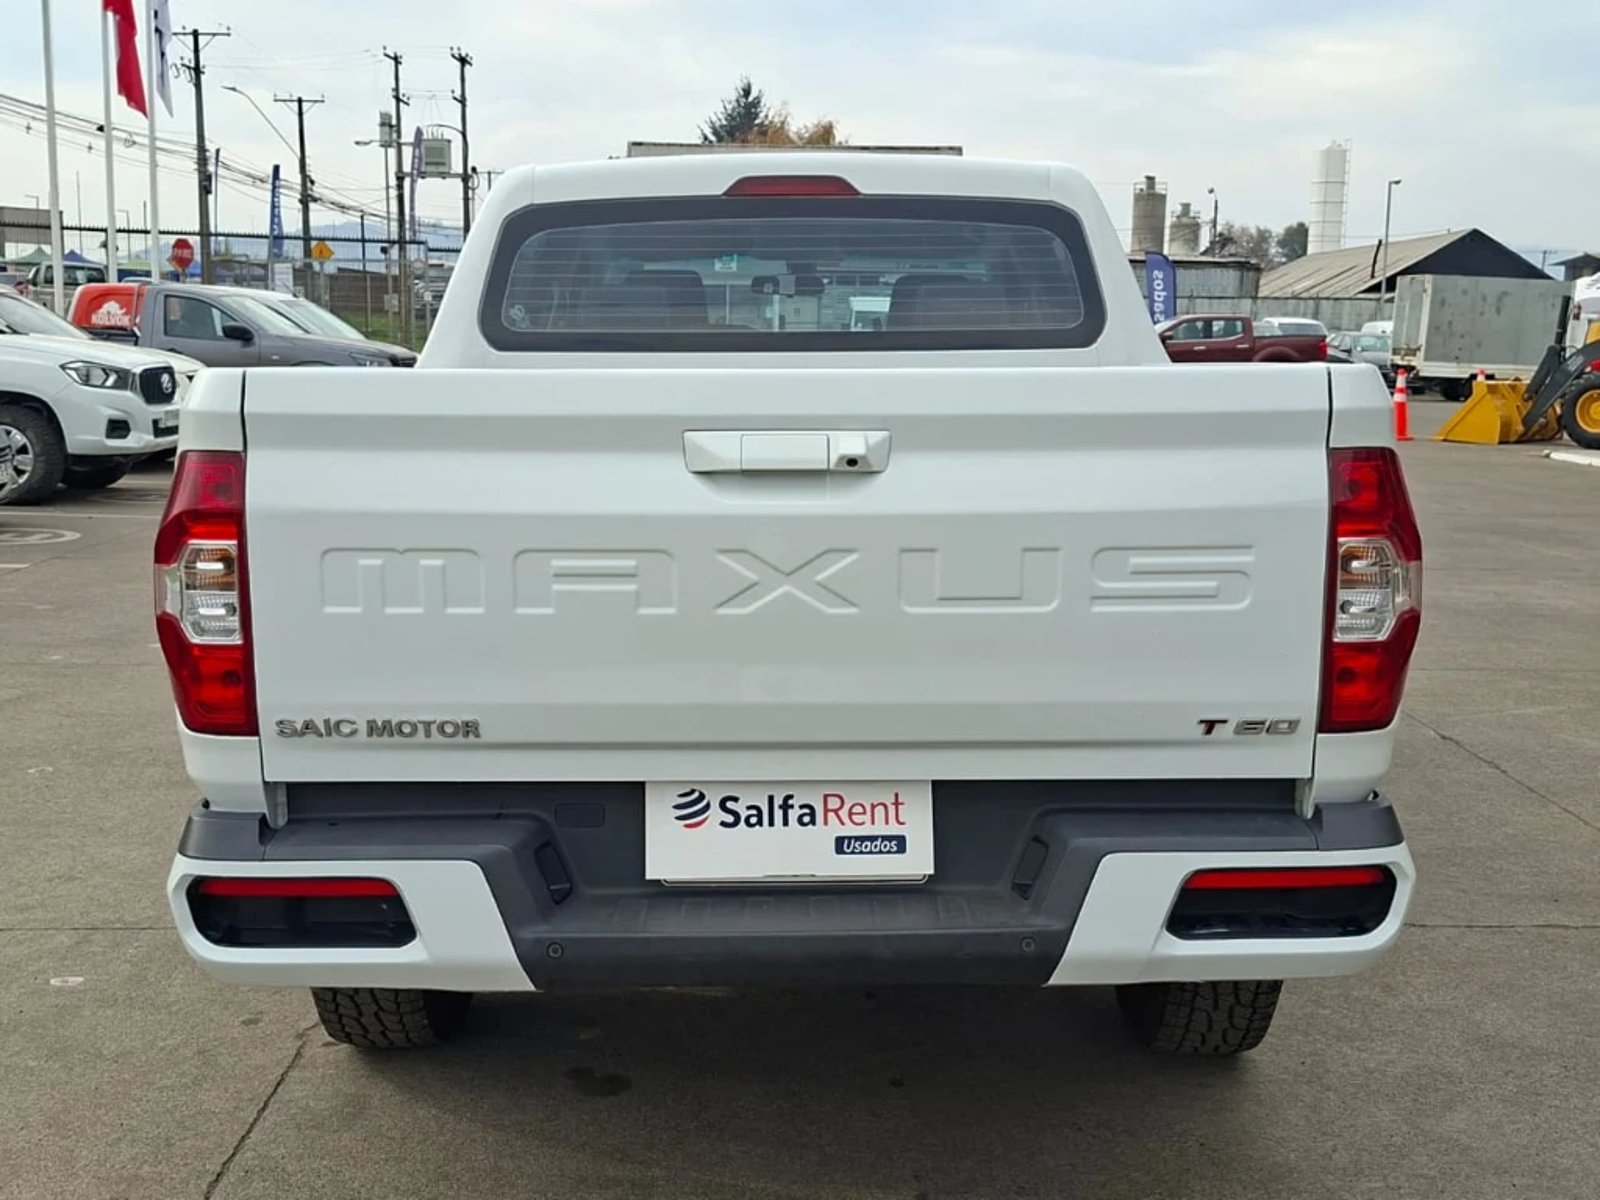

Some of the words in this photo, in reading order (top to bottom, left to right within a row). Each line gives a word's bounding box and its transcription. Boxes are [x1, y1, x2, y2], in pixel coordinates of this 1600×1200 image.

[320, 547, 1255, 615] MAXUS
[275, 718, 358, 738] SAIC
[366, 719, 481, 738] MOTOR
[842, 838, 899, 853] Usados
